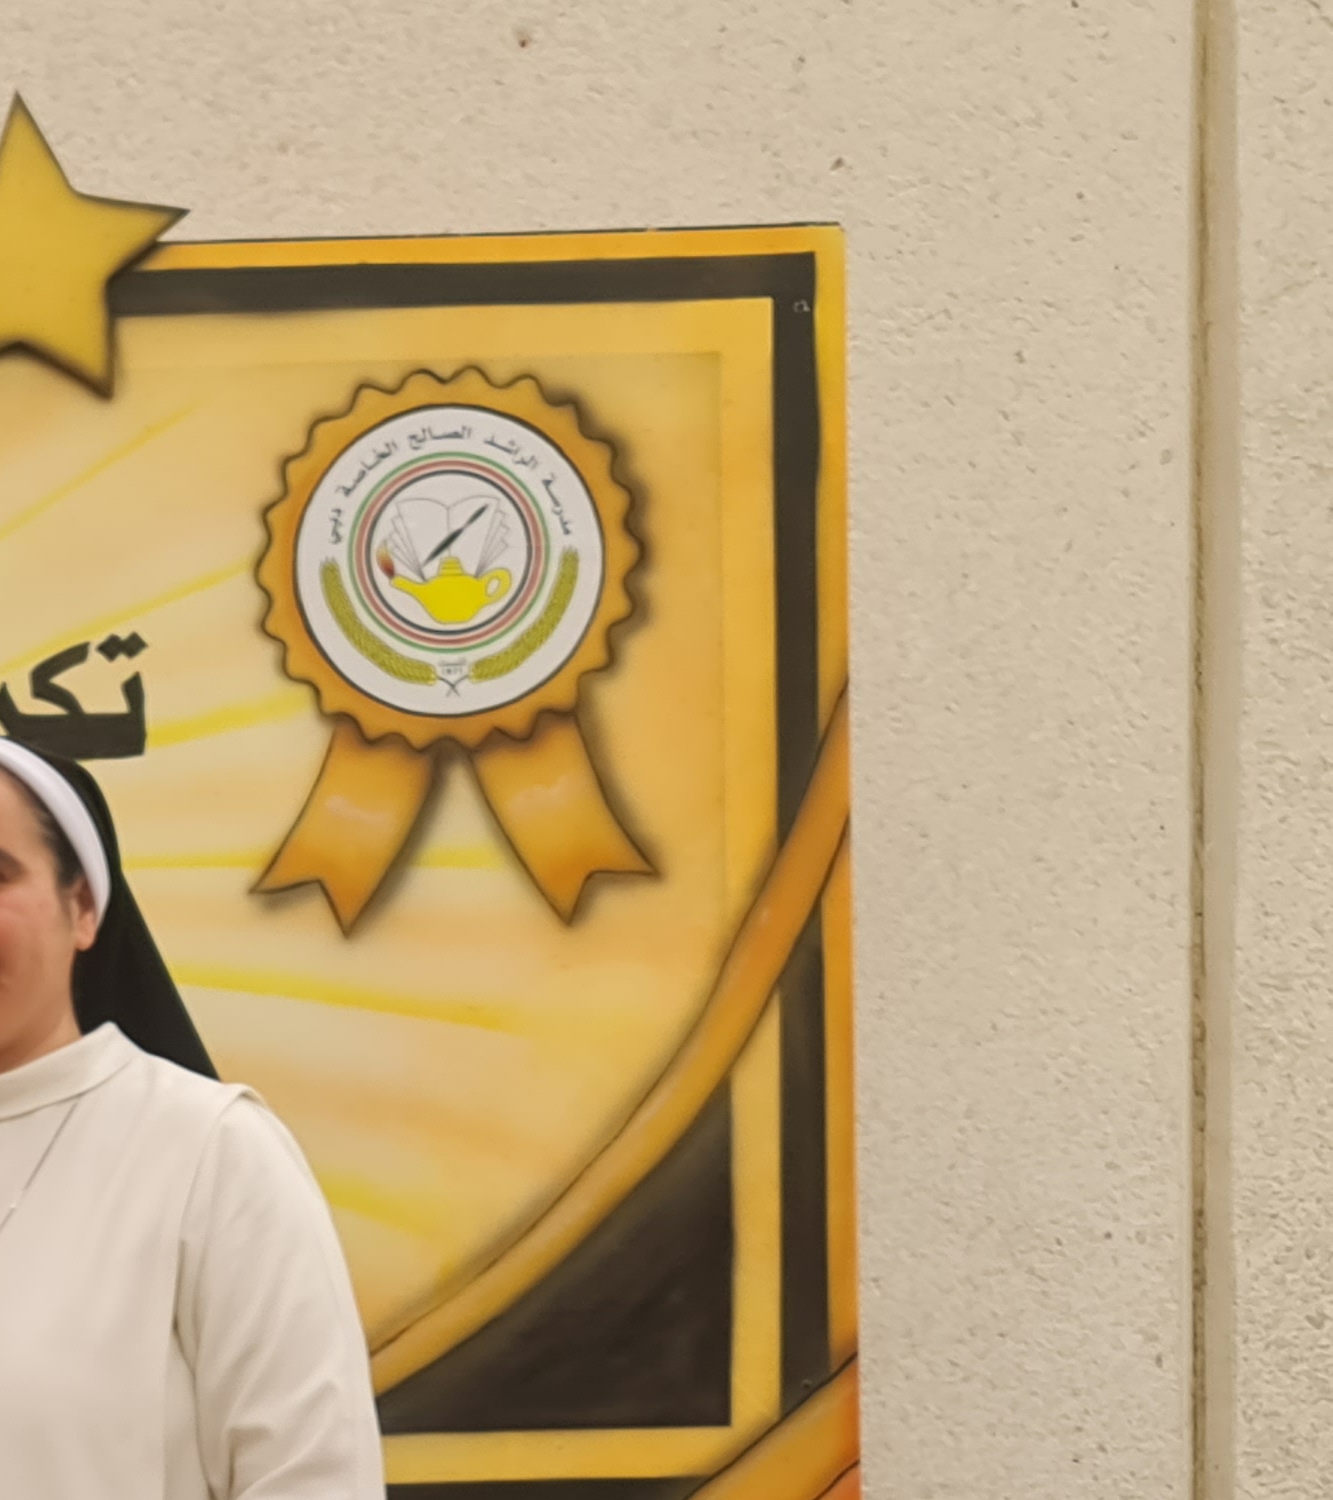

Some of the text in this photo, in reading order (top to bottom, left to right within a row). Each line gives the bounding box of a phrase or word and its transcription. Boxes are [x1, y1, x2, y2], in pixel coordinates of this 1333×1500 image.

[328, 425, 573, 545] مدرسة الراشد الصالح الخاصة دبي
